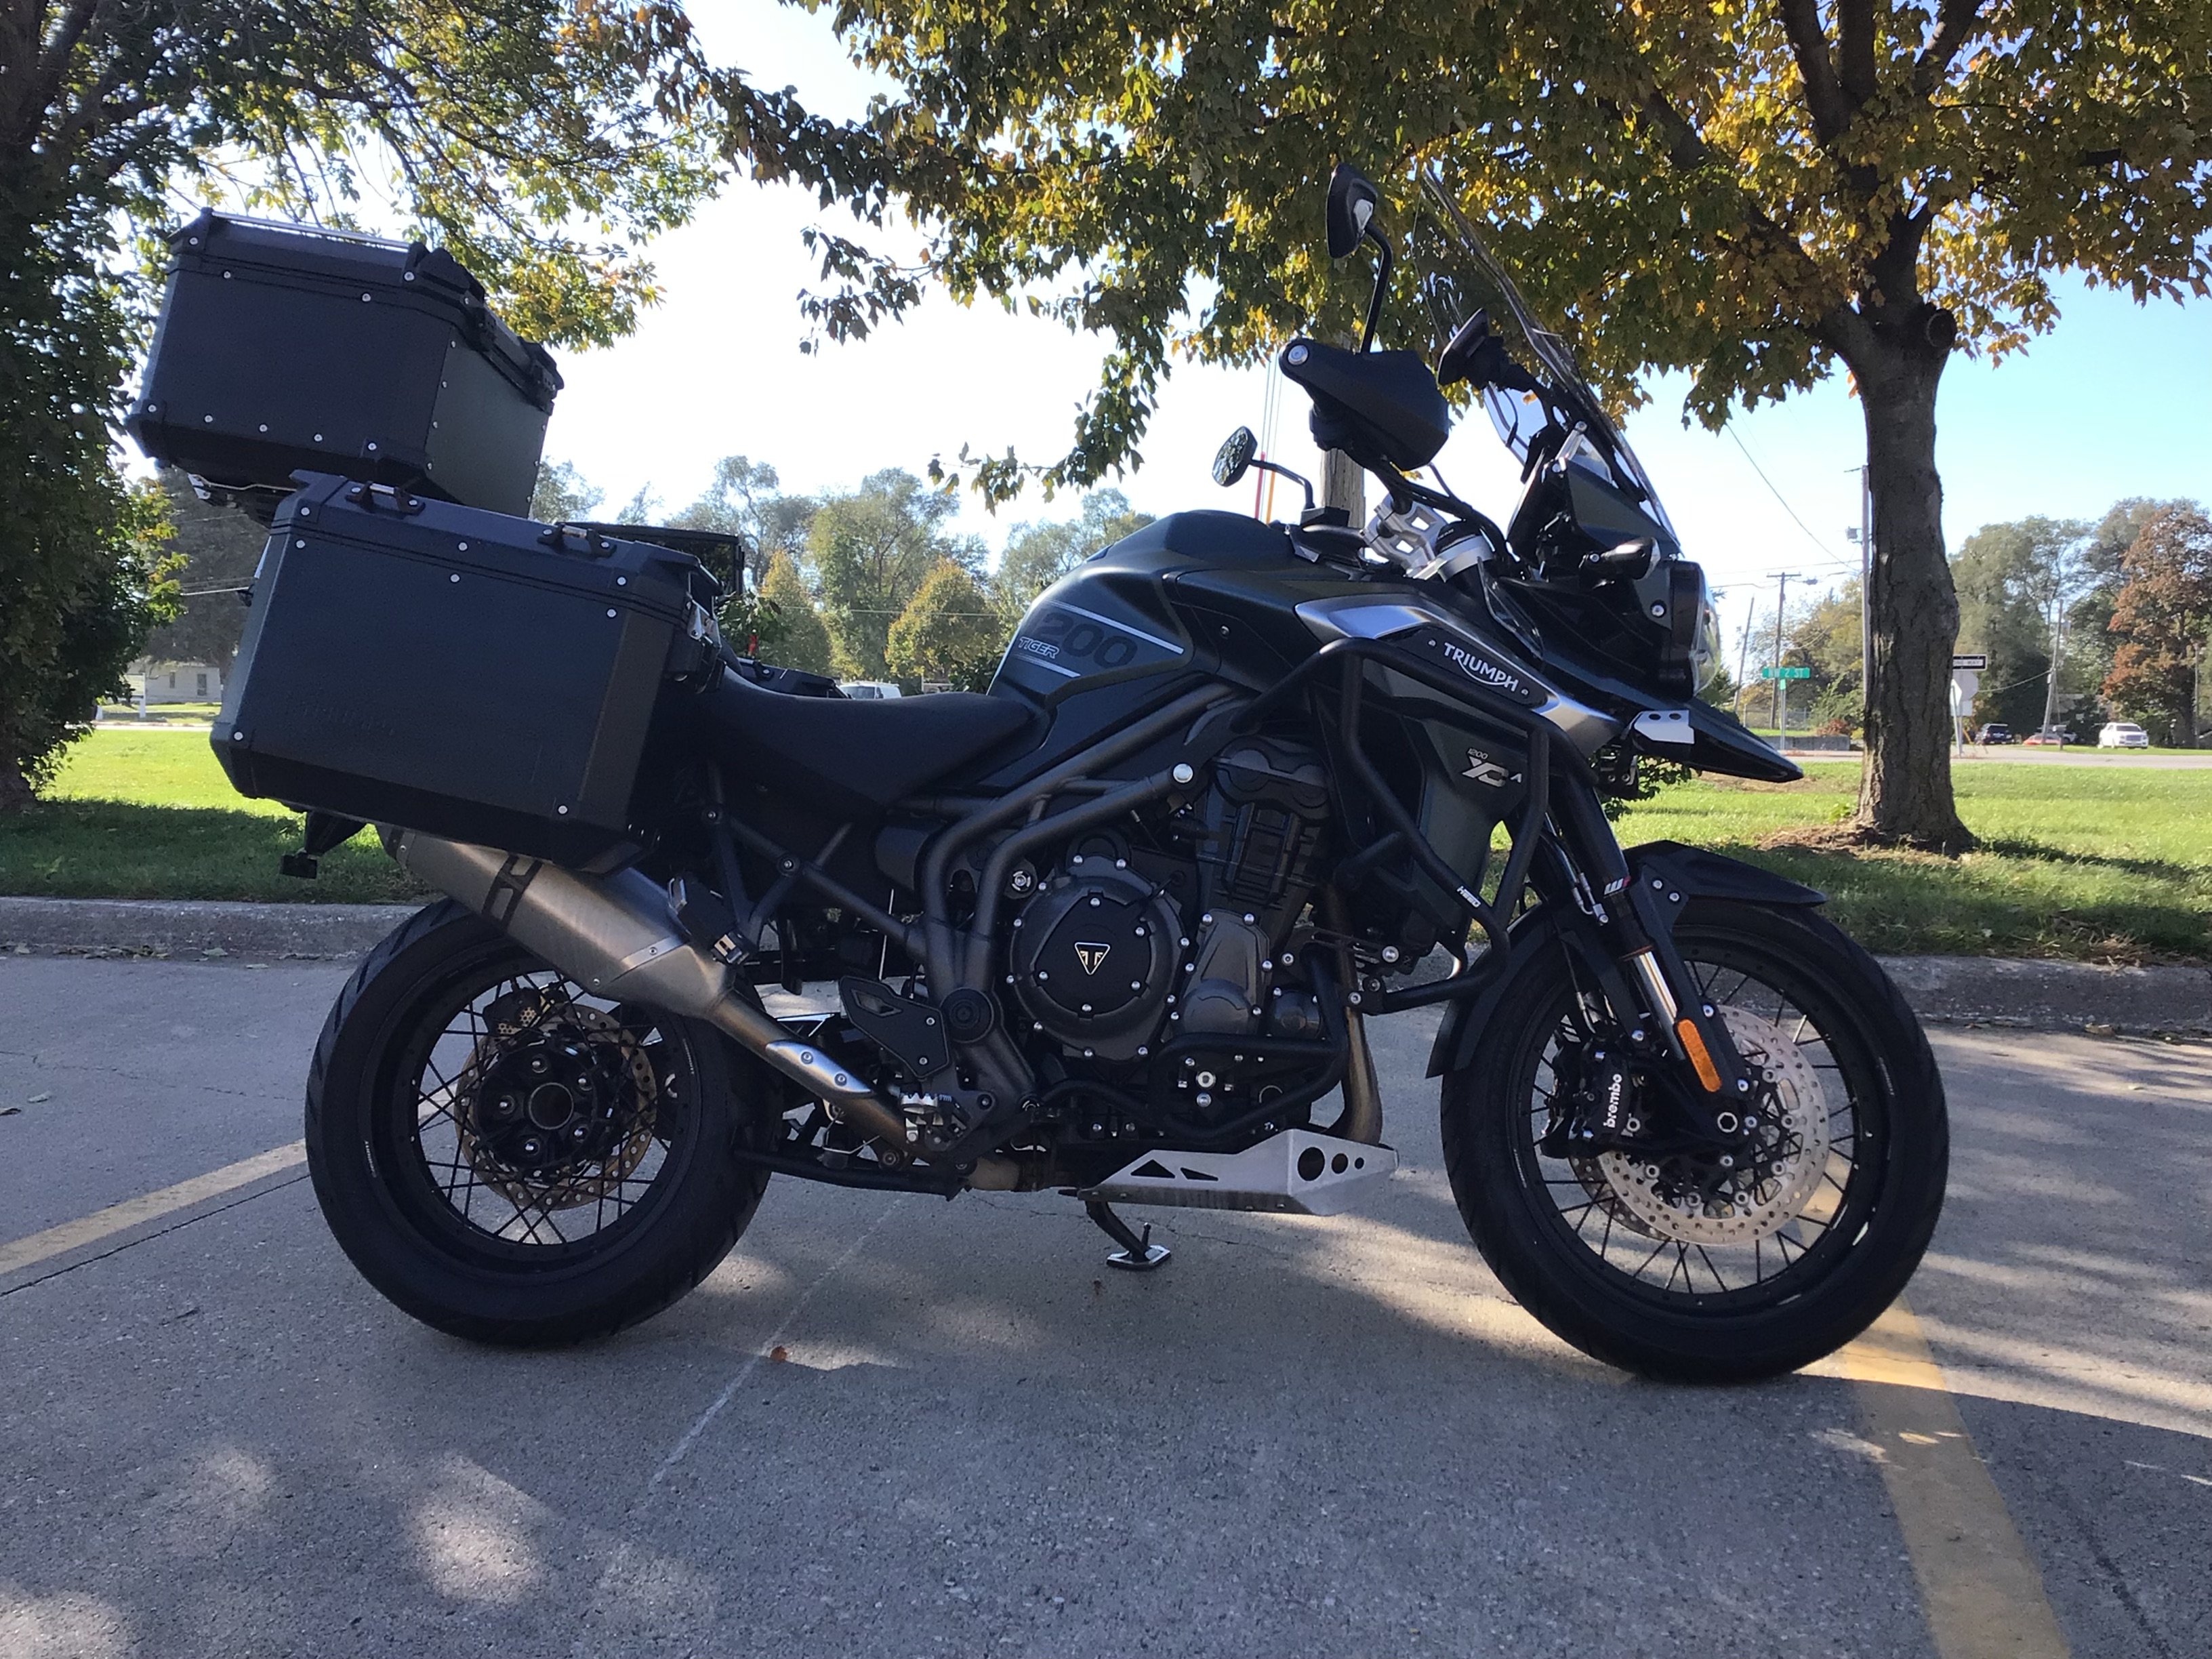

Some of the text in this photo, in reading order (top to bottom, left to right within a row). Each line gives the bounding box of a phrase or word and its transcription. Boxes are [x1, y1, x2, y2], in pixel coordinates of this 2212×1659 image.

[1018, 636, 1060, 659] TIGER
[1444, 642, 1519, 691] TRIUMPH
[1784, 668, 1790, 678] 2
[1794, 668, 1804, 678] ST
[1468, 748, 1488, 760] 1200
[1603, 1073, 1622, 1128] brembo
